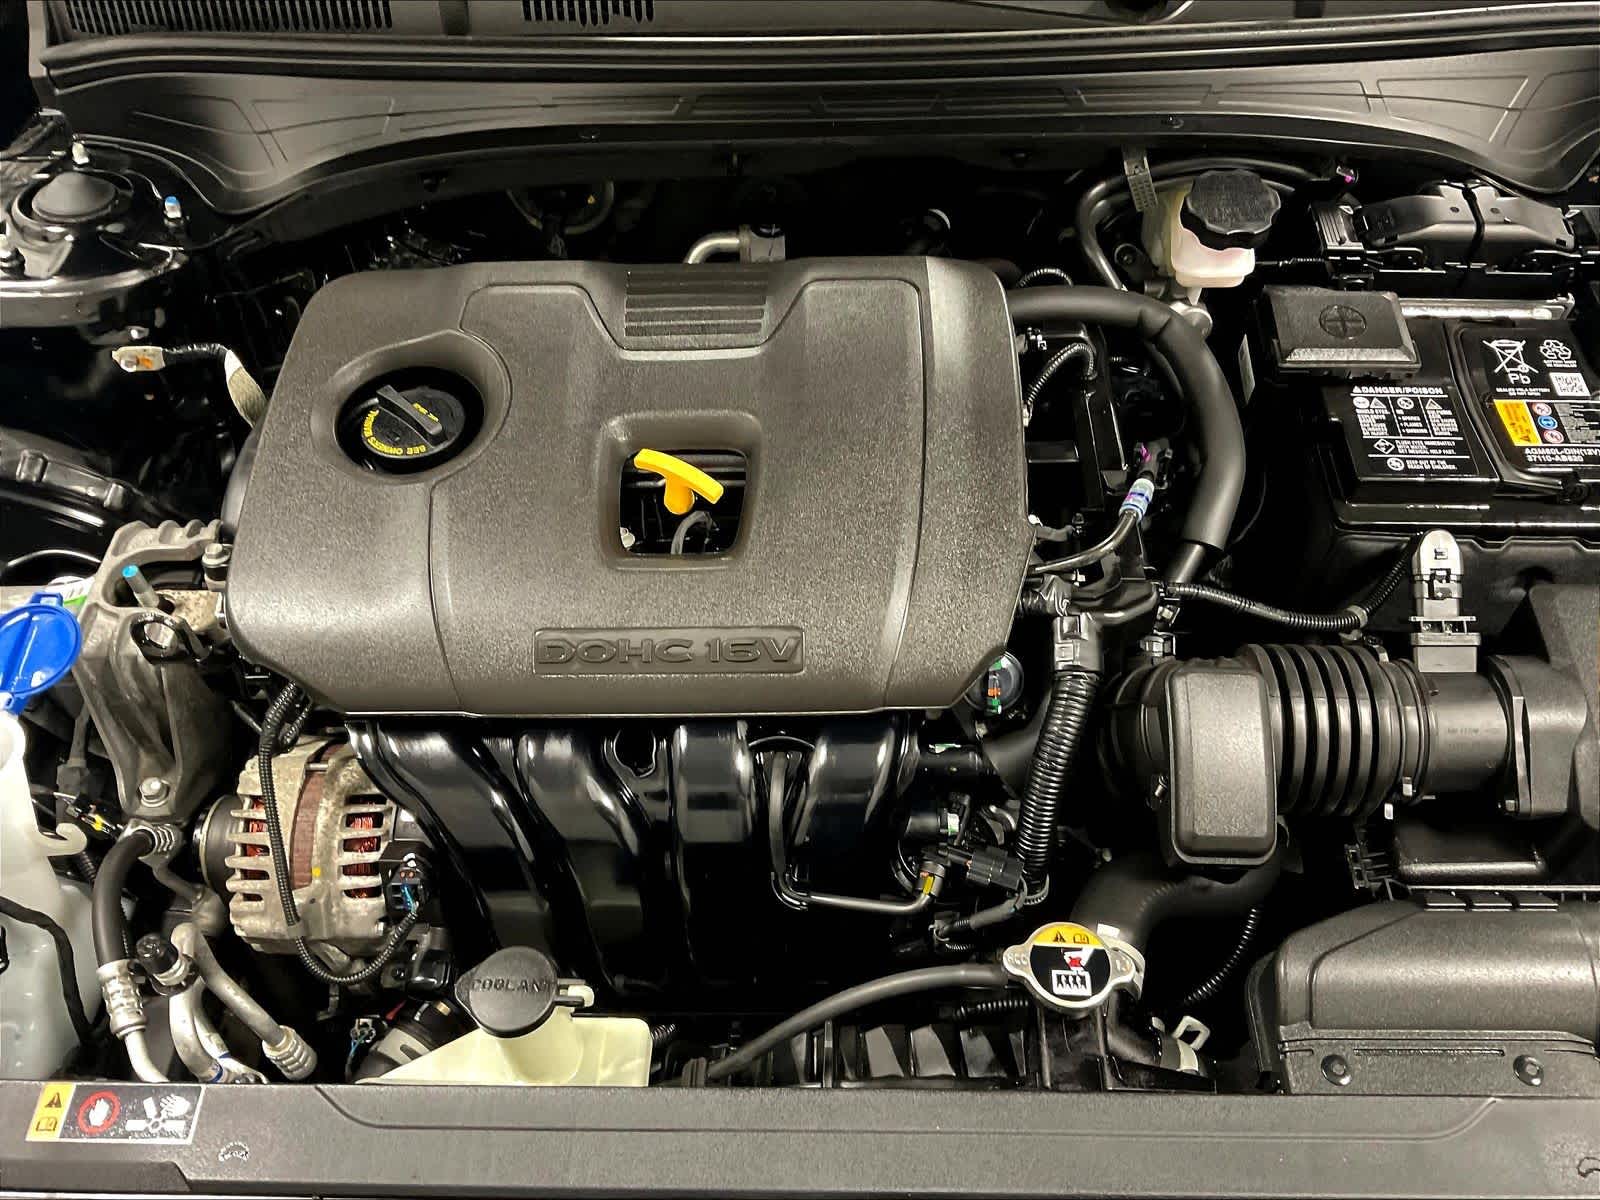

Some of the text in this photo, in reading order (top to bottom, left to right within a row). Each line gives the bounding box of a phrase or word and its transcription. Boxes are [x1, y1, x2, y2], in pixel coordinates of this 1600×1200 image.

[1508, 373, 1531, 385] Pb
[1361, 386, 1444, 395] DANGER/POISON
[538, 637, 801, 664] DOHC 16V
